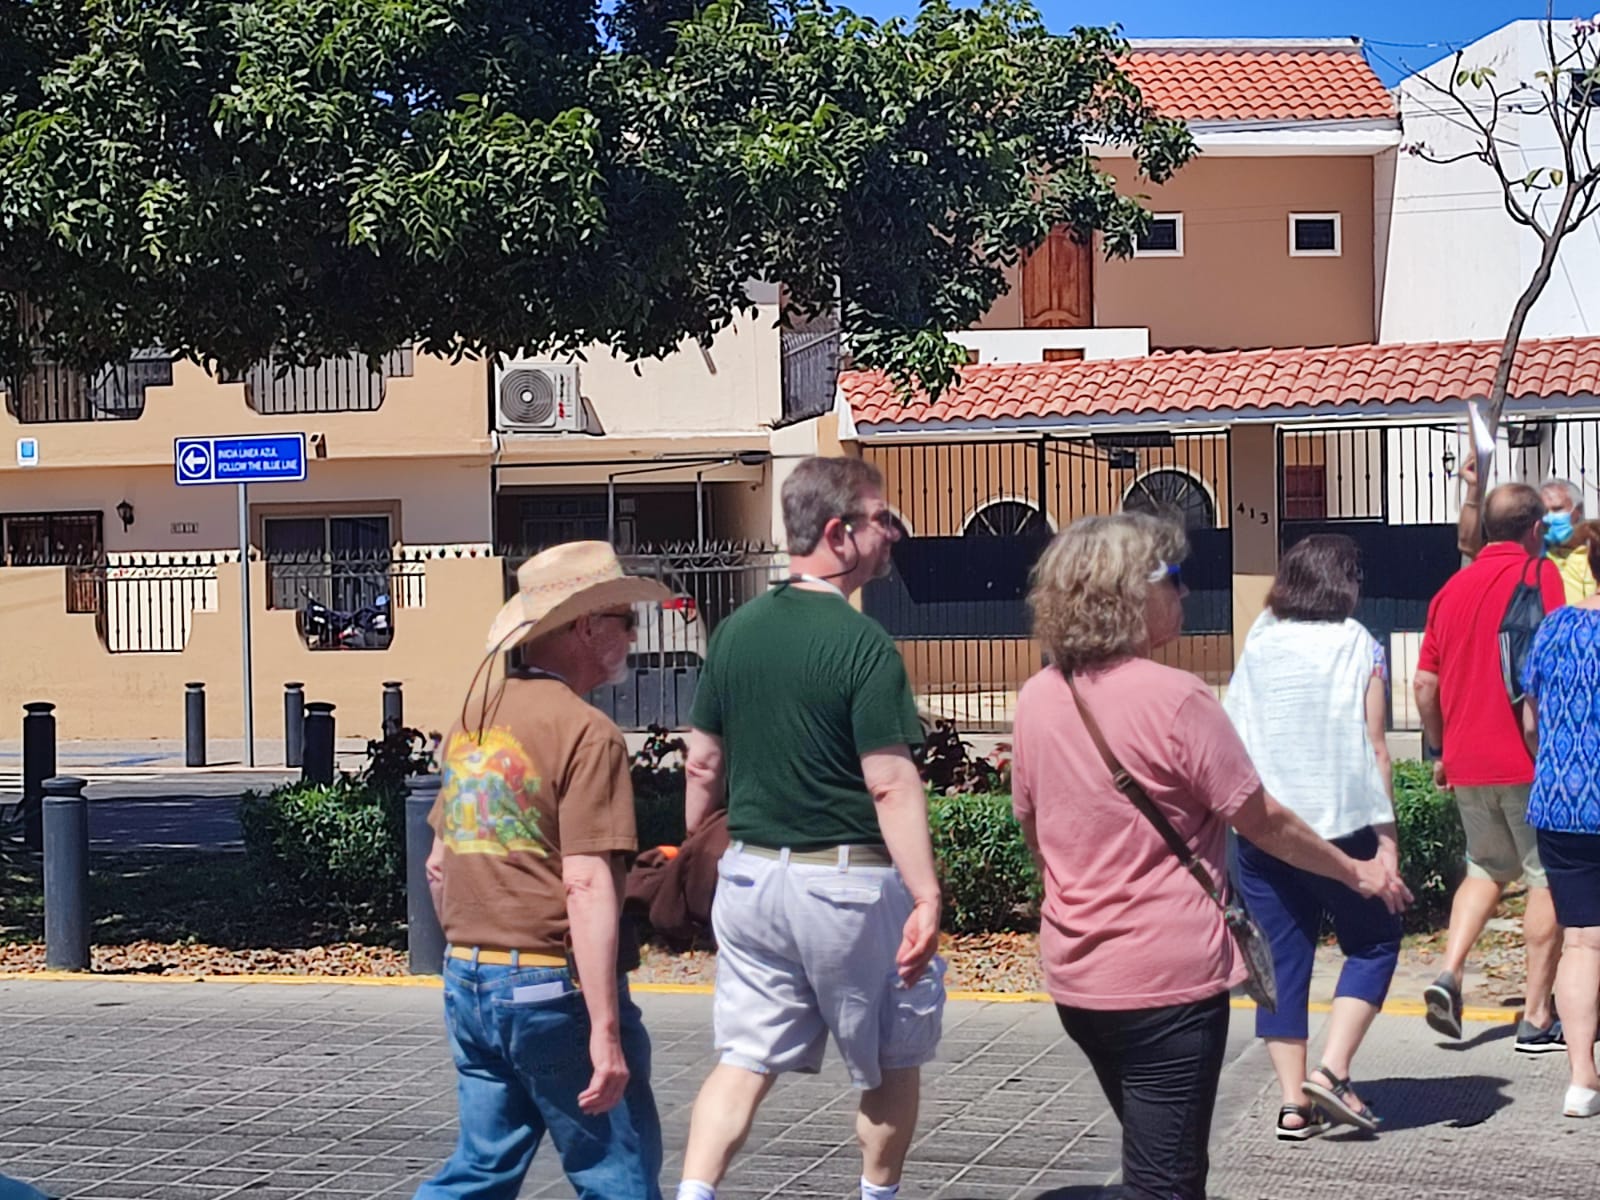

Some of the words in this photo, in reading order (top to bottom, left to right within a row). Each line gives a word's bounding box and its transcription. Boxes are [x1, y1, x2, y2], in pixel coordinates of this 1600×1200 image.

[217, 461, 247, 473] FOLLOW
[247, 460, 261, 471] THE
[262, 459, 281, 471] BLUE
[281, 458, 298, 470] LINE
[1236, 501, 1269, 525] 413
